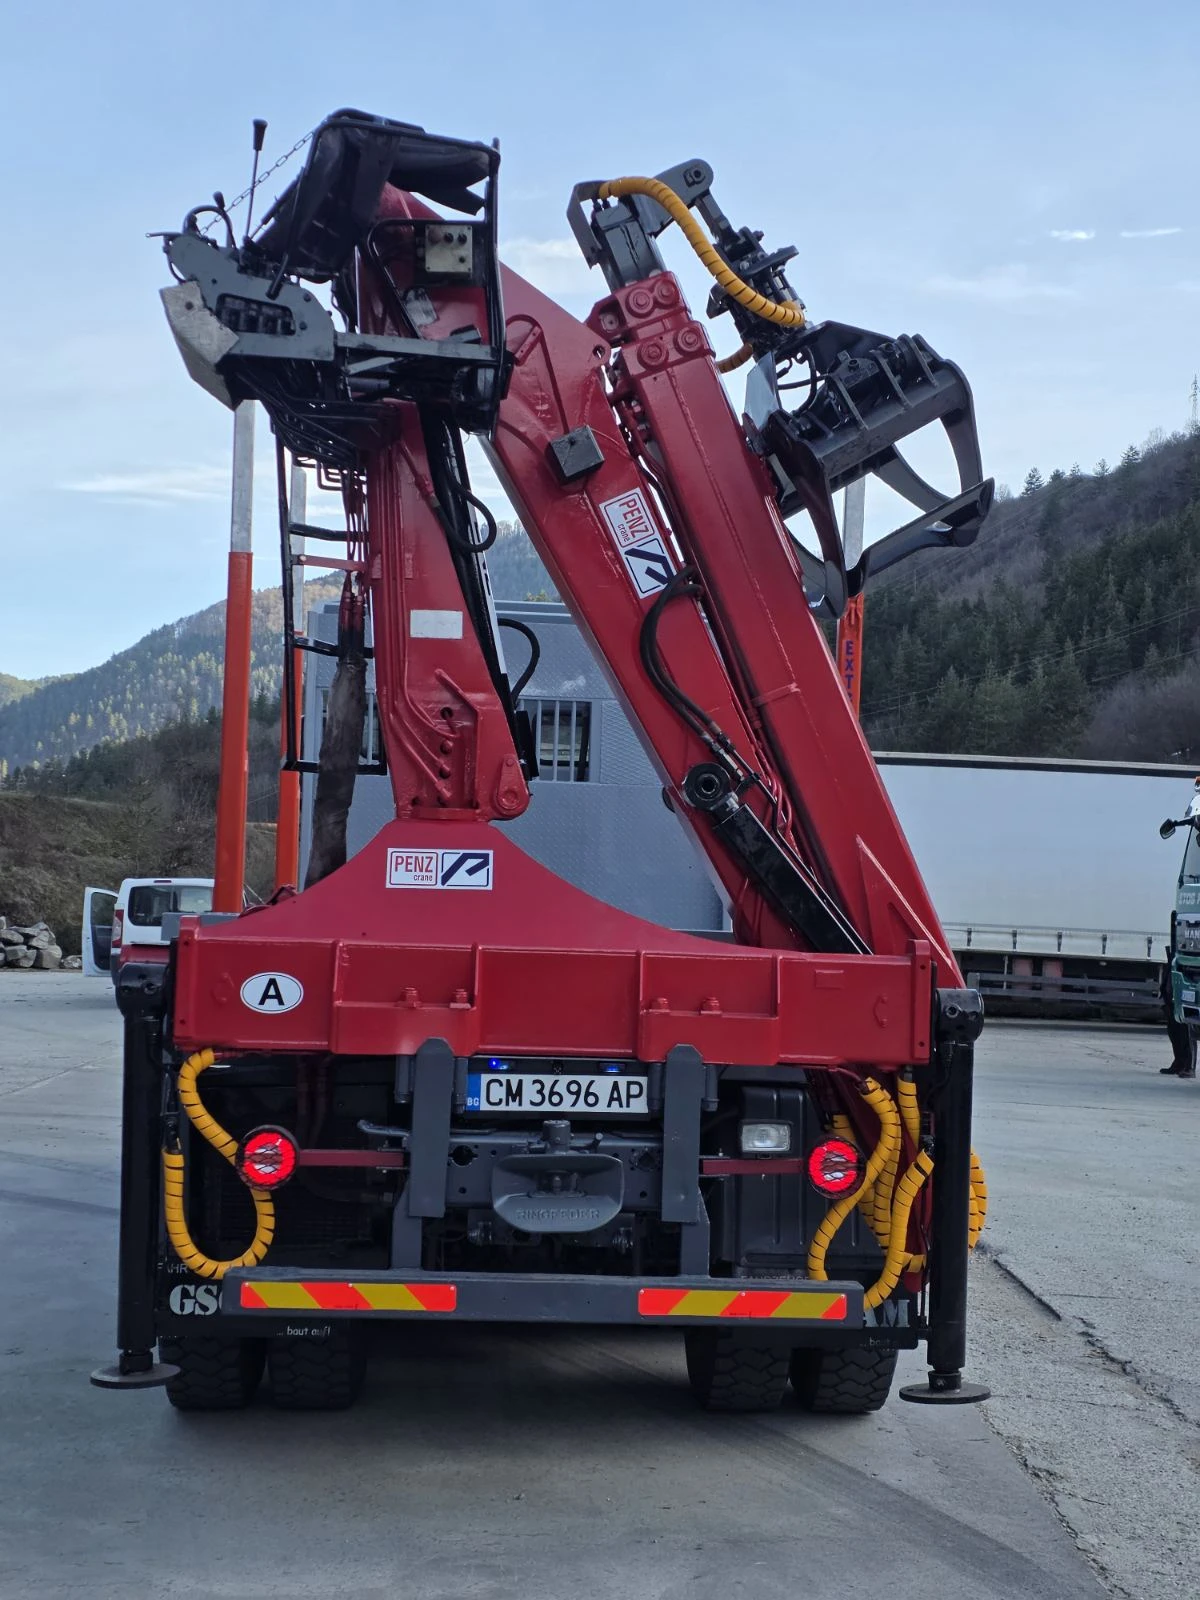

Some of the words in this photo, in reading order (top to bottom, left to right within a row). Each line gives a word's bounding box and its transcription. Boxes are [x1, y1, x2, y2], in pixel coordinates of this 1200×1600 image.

[619, 498, 650, 539] PENZ
[617, 523, 631, 543] crane
[394, 855, 434, 873] PENZ
[413, 874, 433, 882] crane
[258, 977, 285, 1006] A
[467, 1097, 480, 1107] BG
[485, 1078, 523, 1107] CM
[529, 1079, 600, 1108] 3696
[607, 1080, 644, 1109] AP
[516, 1207, 600, 1220] RINGFEDER
[169, 1284, 223, 1316] GS
